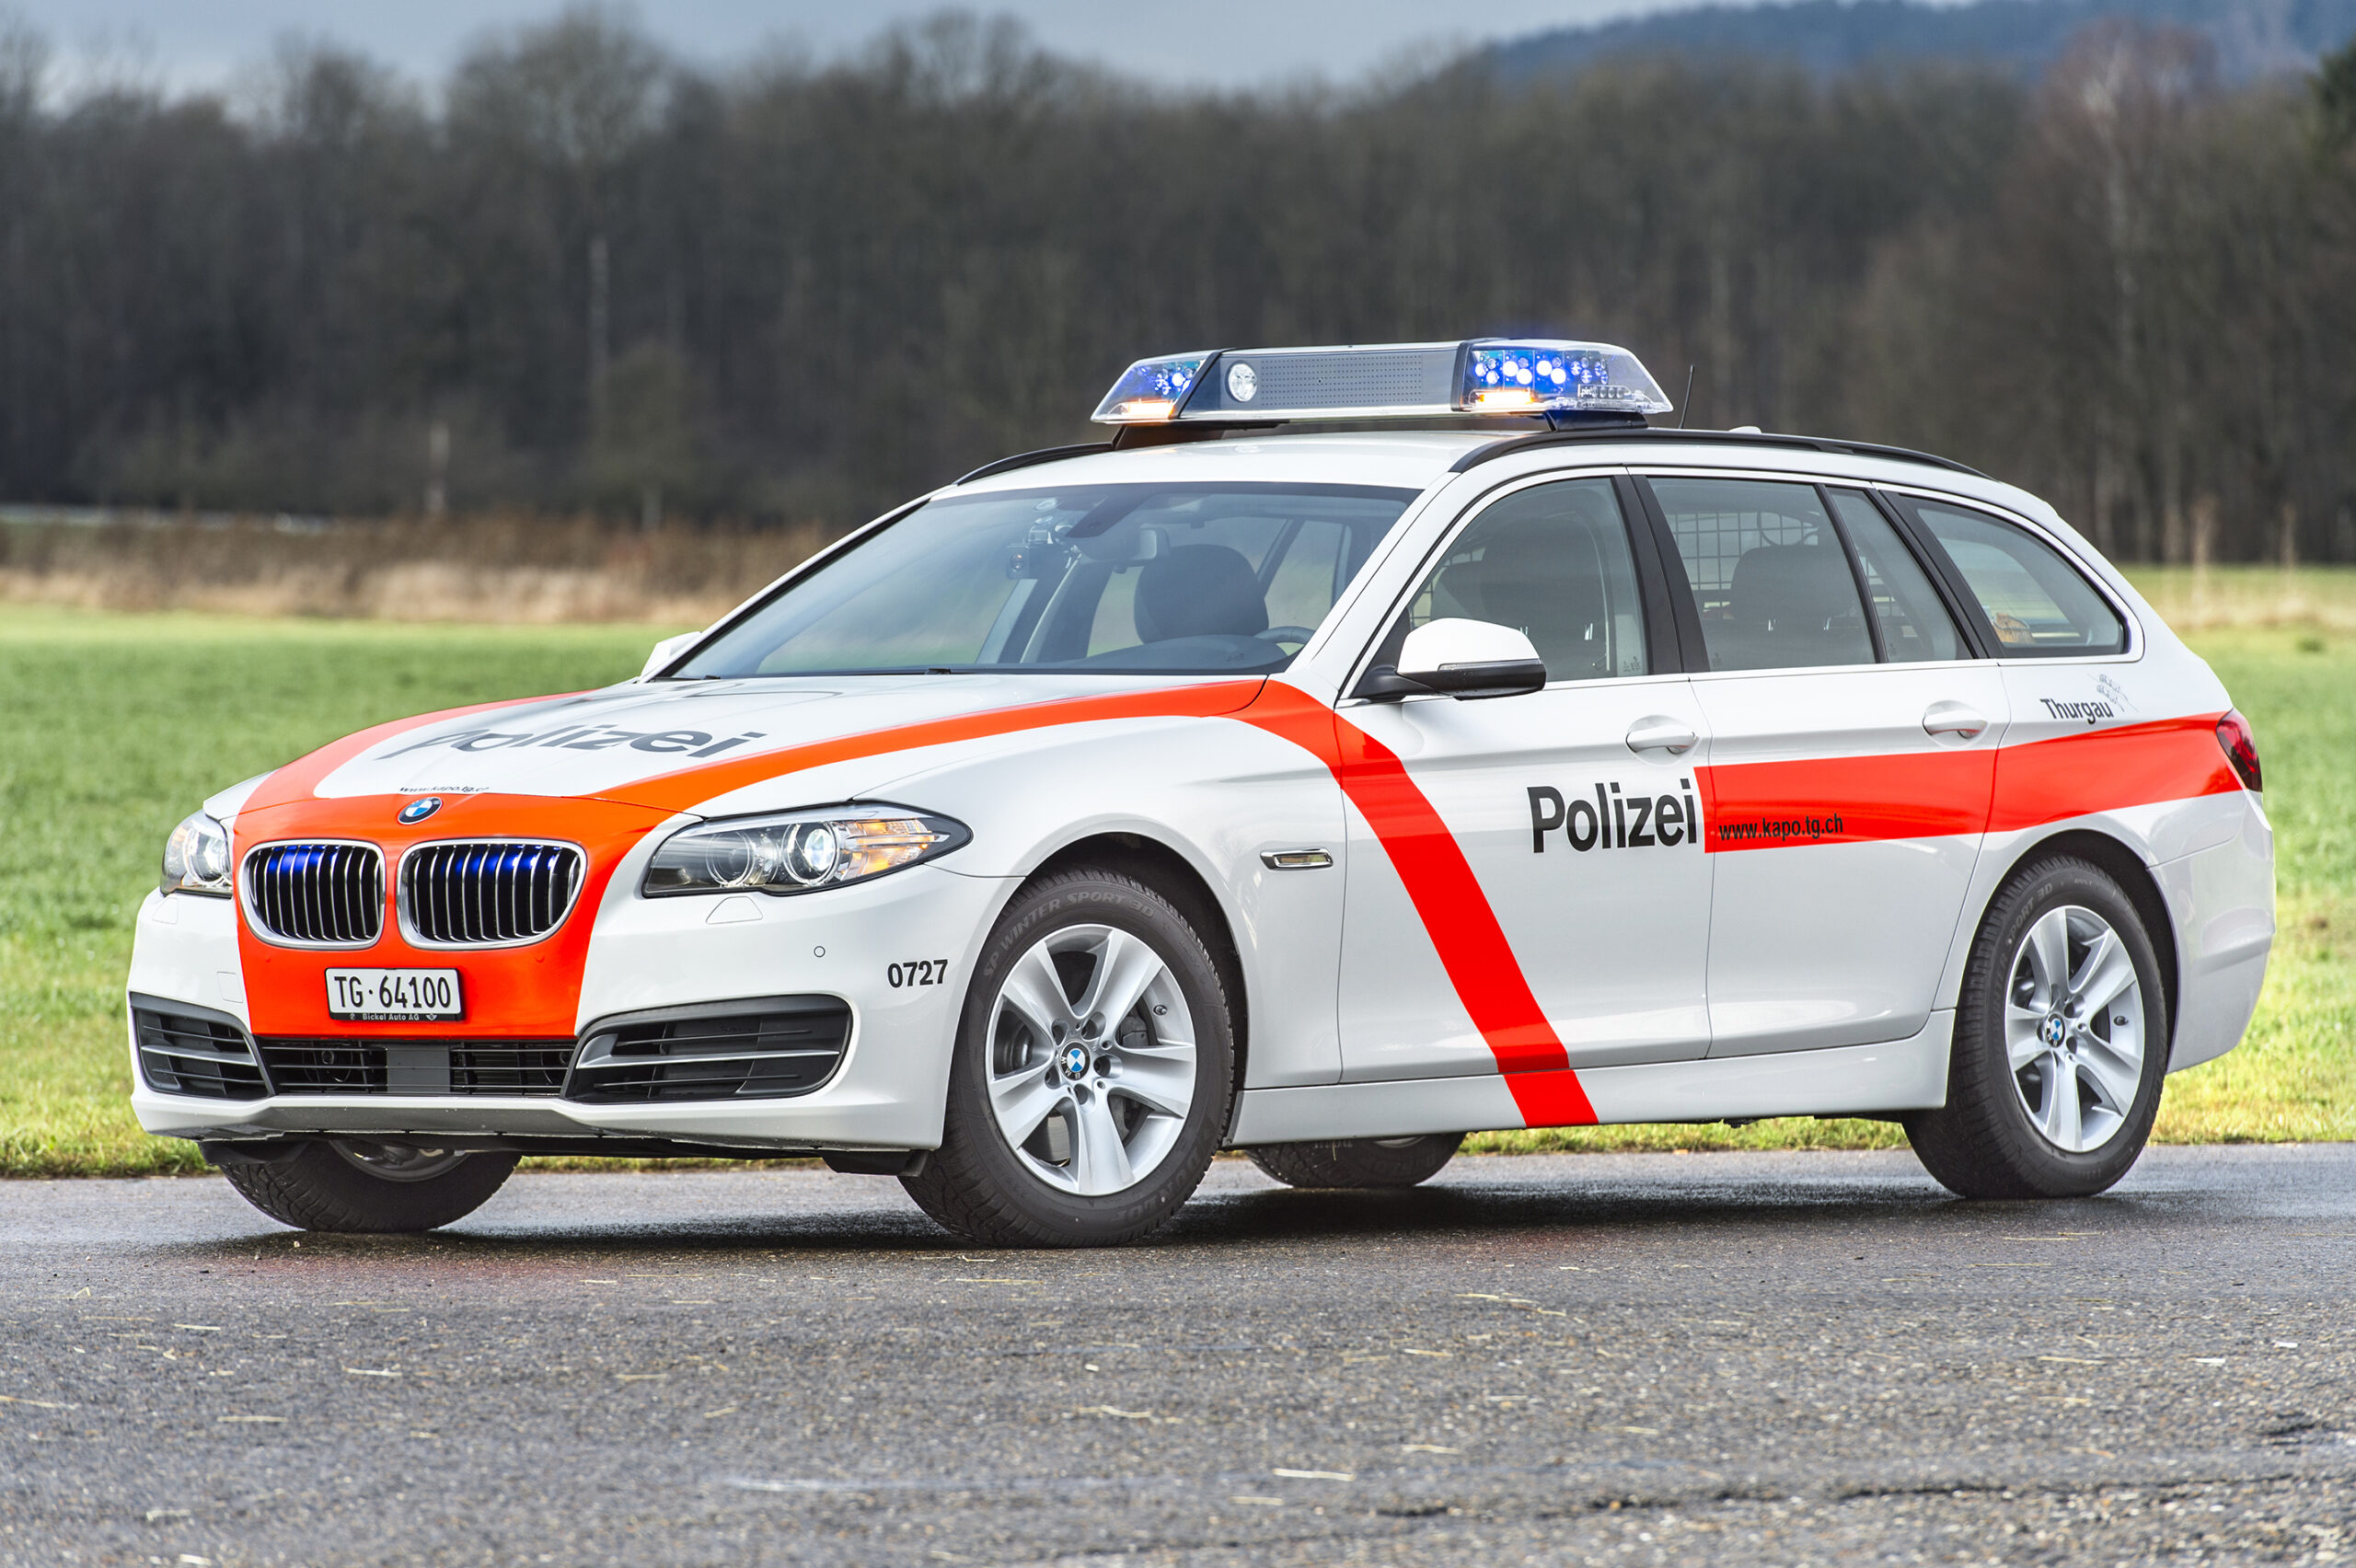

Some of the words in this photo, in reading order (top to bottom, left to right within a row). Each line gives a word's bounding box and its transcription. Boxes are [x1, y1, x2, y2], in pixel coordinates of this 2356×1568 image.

[2039, 698, 2115, 725] Thurgau
[373, 723, 768, 761] Polizei
[1526, 778, 1698, 854] Polizei
[1718, 813, 1844, 844] www.kapo.tg.ch
[999, 897, 1062, 951] WINTER
[1066, 891, 1126, 906] SPORT
[887, 959, 948, 988] 0727
